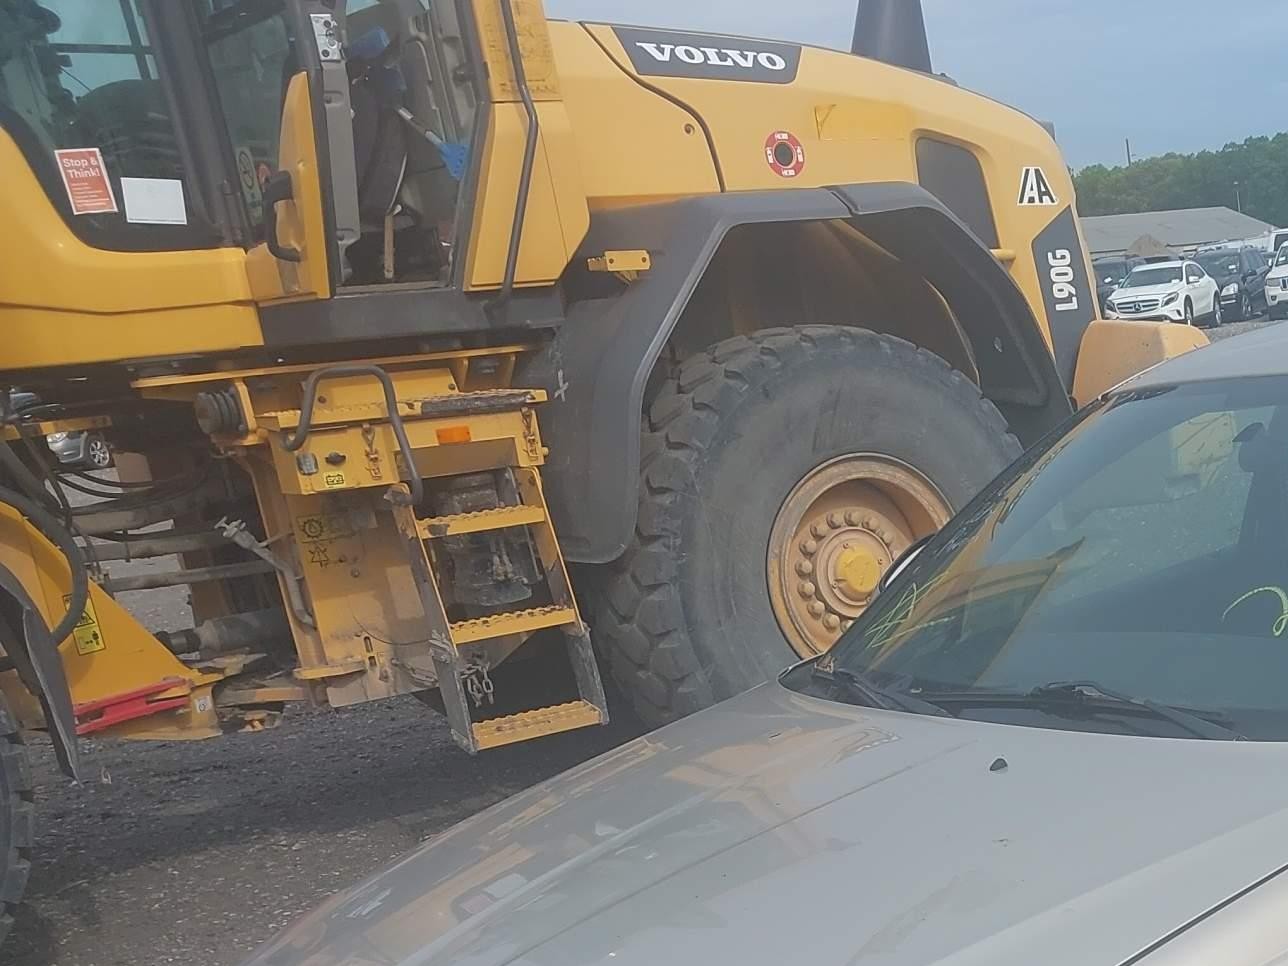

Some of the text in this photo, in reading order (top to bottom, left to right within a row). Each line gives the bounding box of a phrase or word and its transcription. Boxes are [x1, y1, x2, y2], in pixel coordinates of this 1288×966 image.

[635, 42, 786, 71] VOLVO
[63, 157, 99, 168] Stop &
[66, 167, 100, 179] Think!
[1047, 248, 1079, 311] L90G
